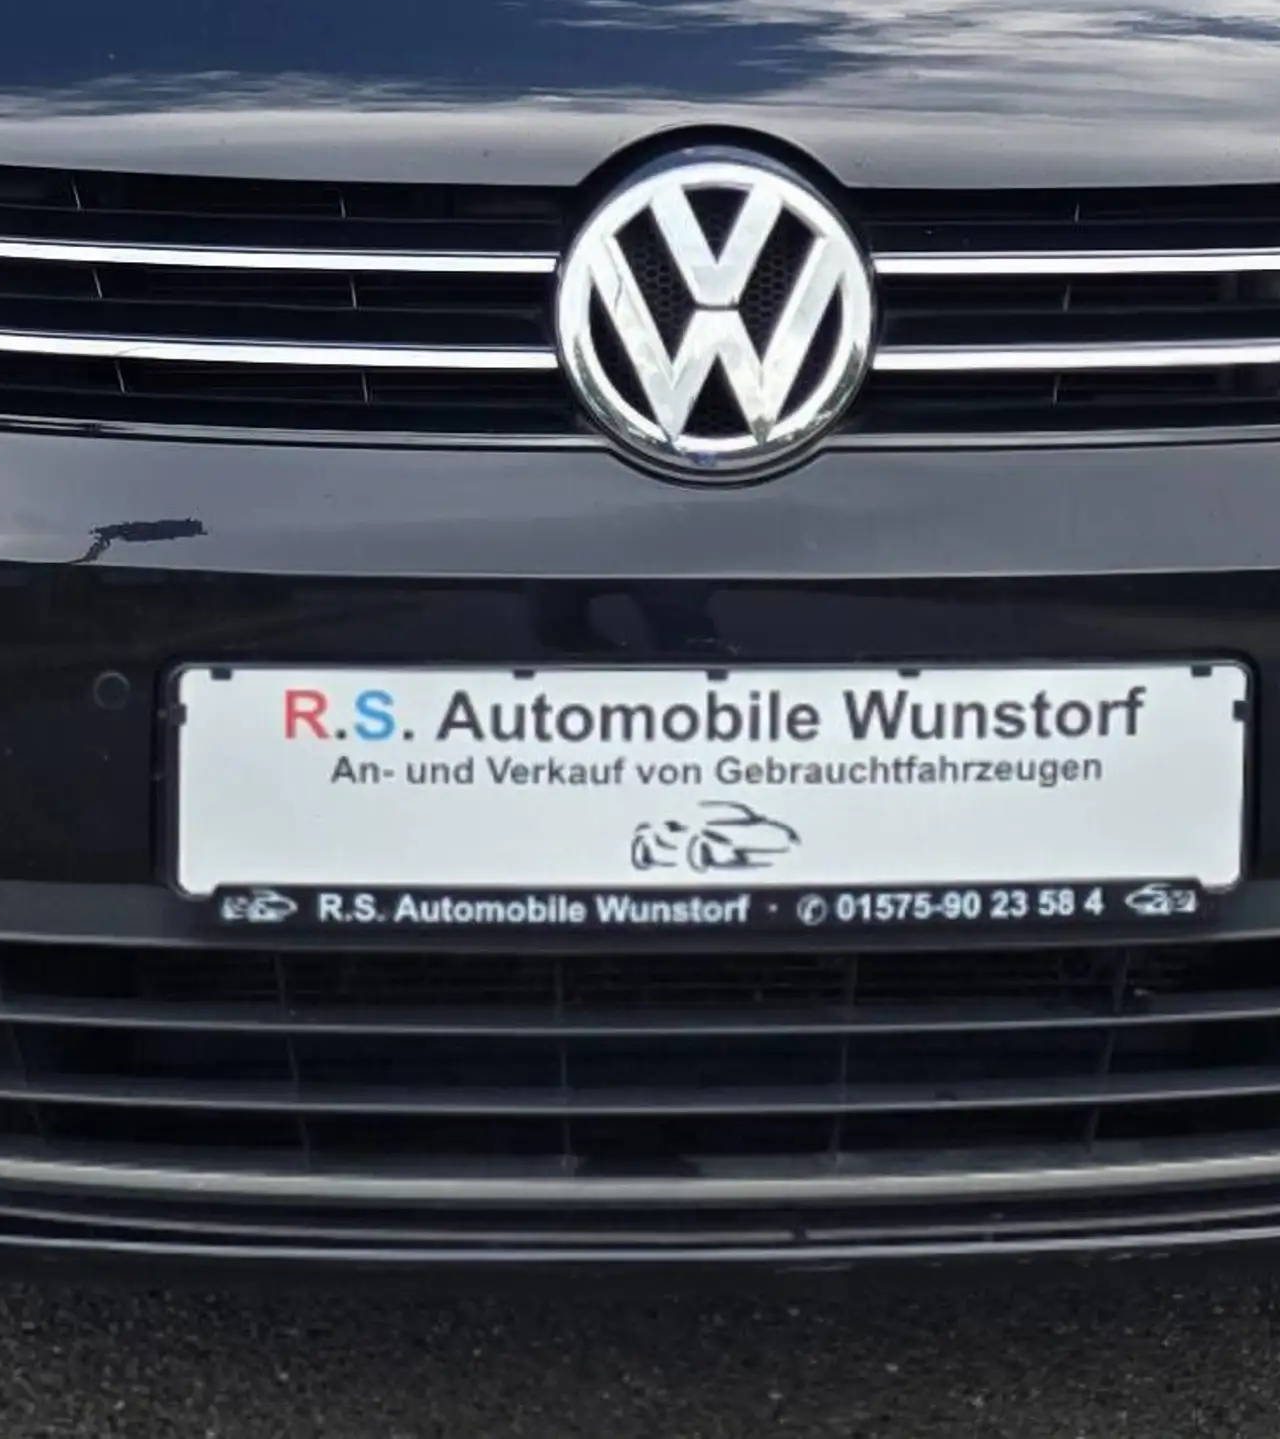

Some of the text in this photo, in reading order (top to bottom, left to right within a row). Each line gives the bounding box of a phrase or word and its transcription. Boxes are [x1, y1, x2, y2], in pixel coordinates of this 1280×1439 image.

[284, 686, 1147, 742] R.S. Automobile Wunstorf
[331, 754, 1103, 788] An- und Verkauf von Gebrauchtfahrzeugen
[319, 887, 1104, 923] R.S. Automobile Wunstorf 01575-90 23 58 4
